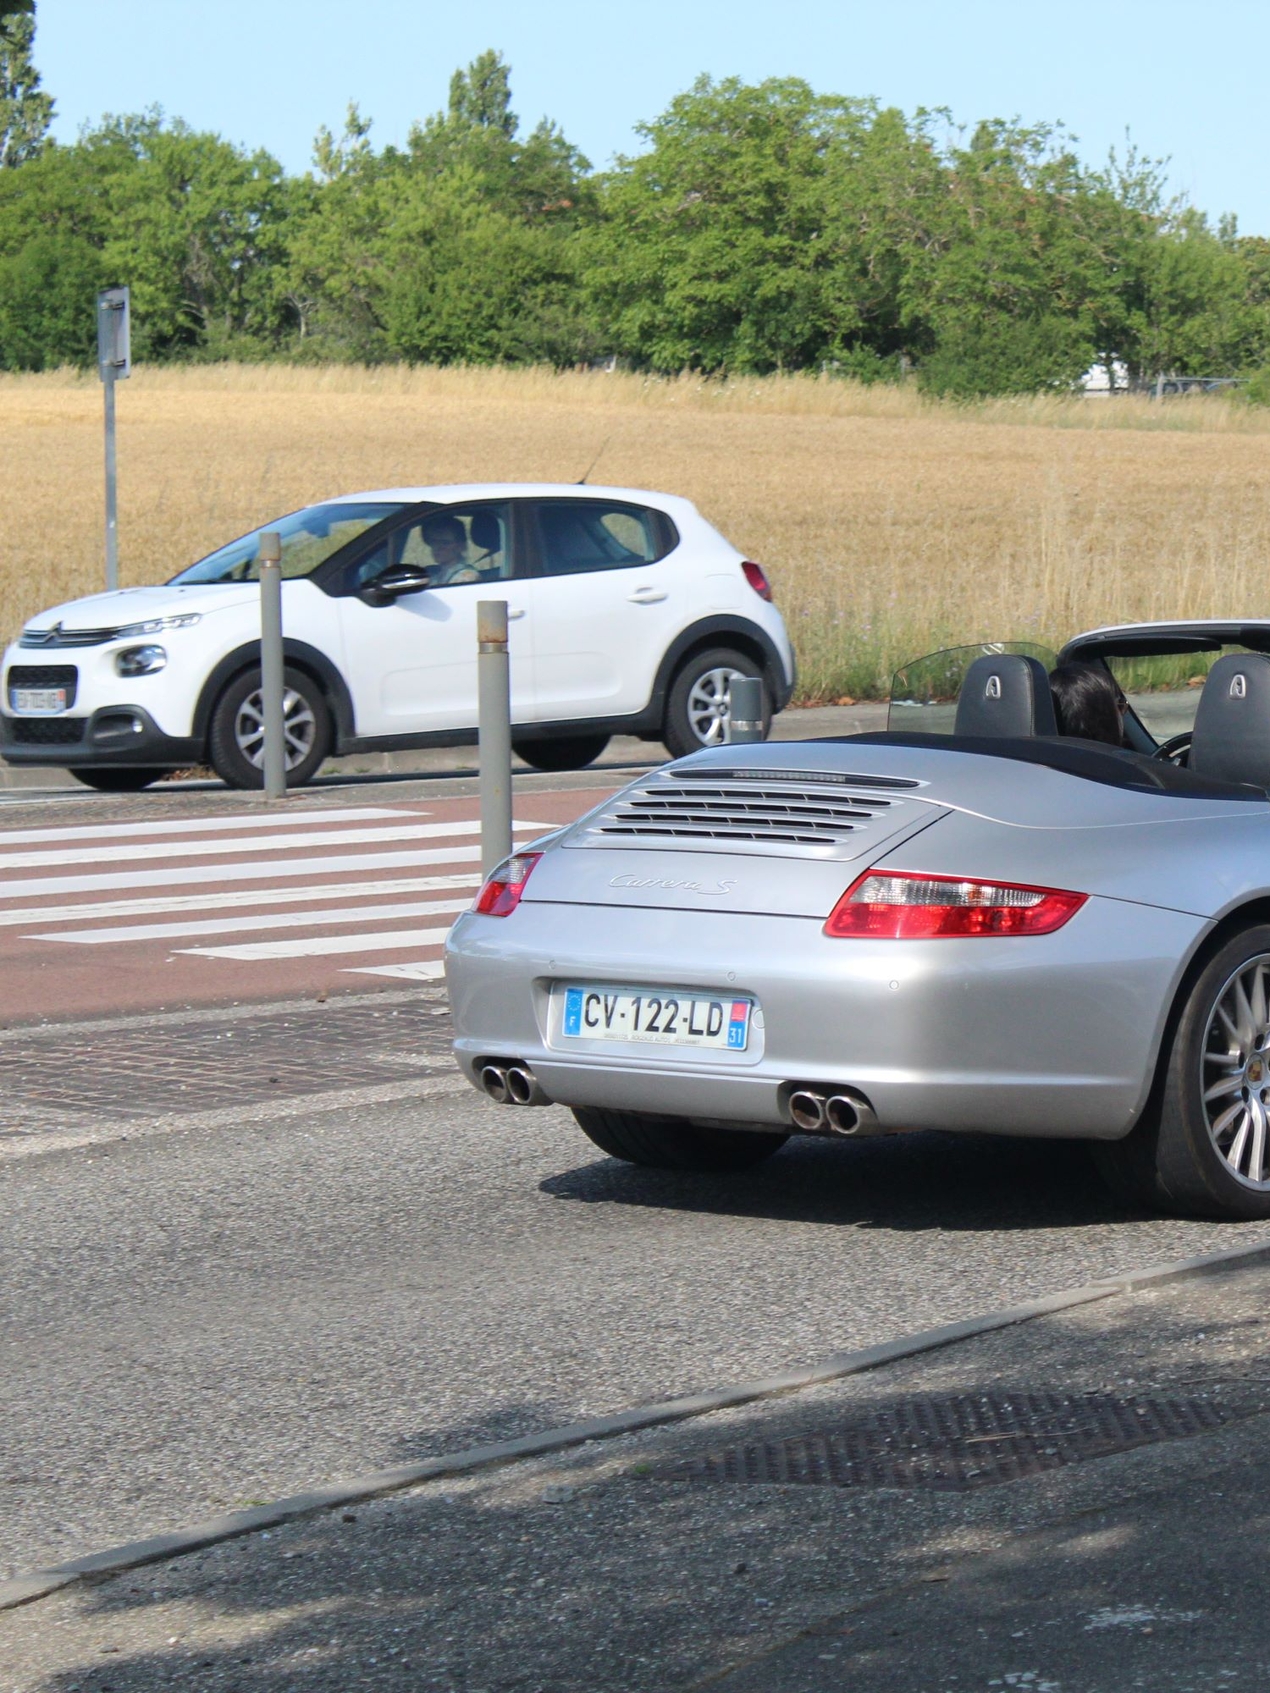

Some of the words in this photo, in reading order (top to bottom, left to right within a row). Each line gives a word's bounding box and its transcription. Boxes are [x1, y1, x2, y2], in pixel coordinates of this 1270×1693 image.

[608, 873, 701, 890] Carrera
[697, 879, 738, 895] S
[584, 993, 724, 1037] CV-122-LD
[728, 1027, 743, 1044] 31
